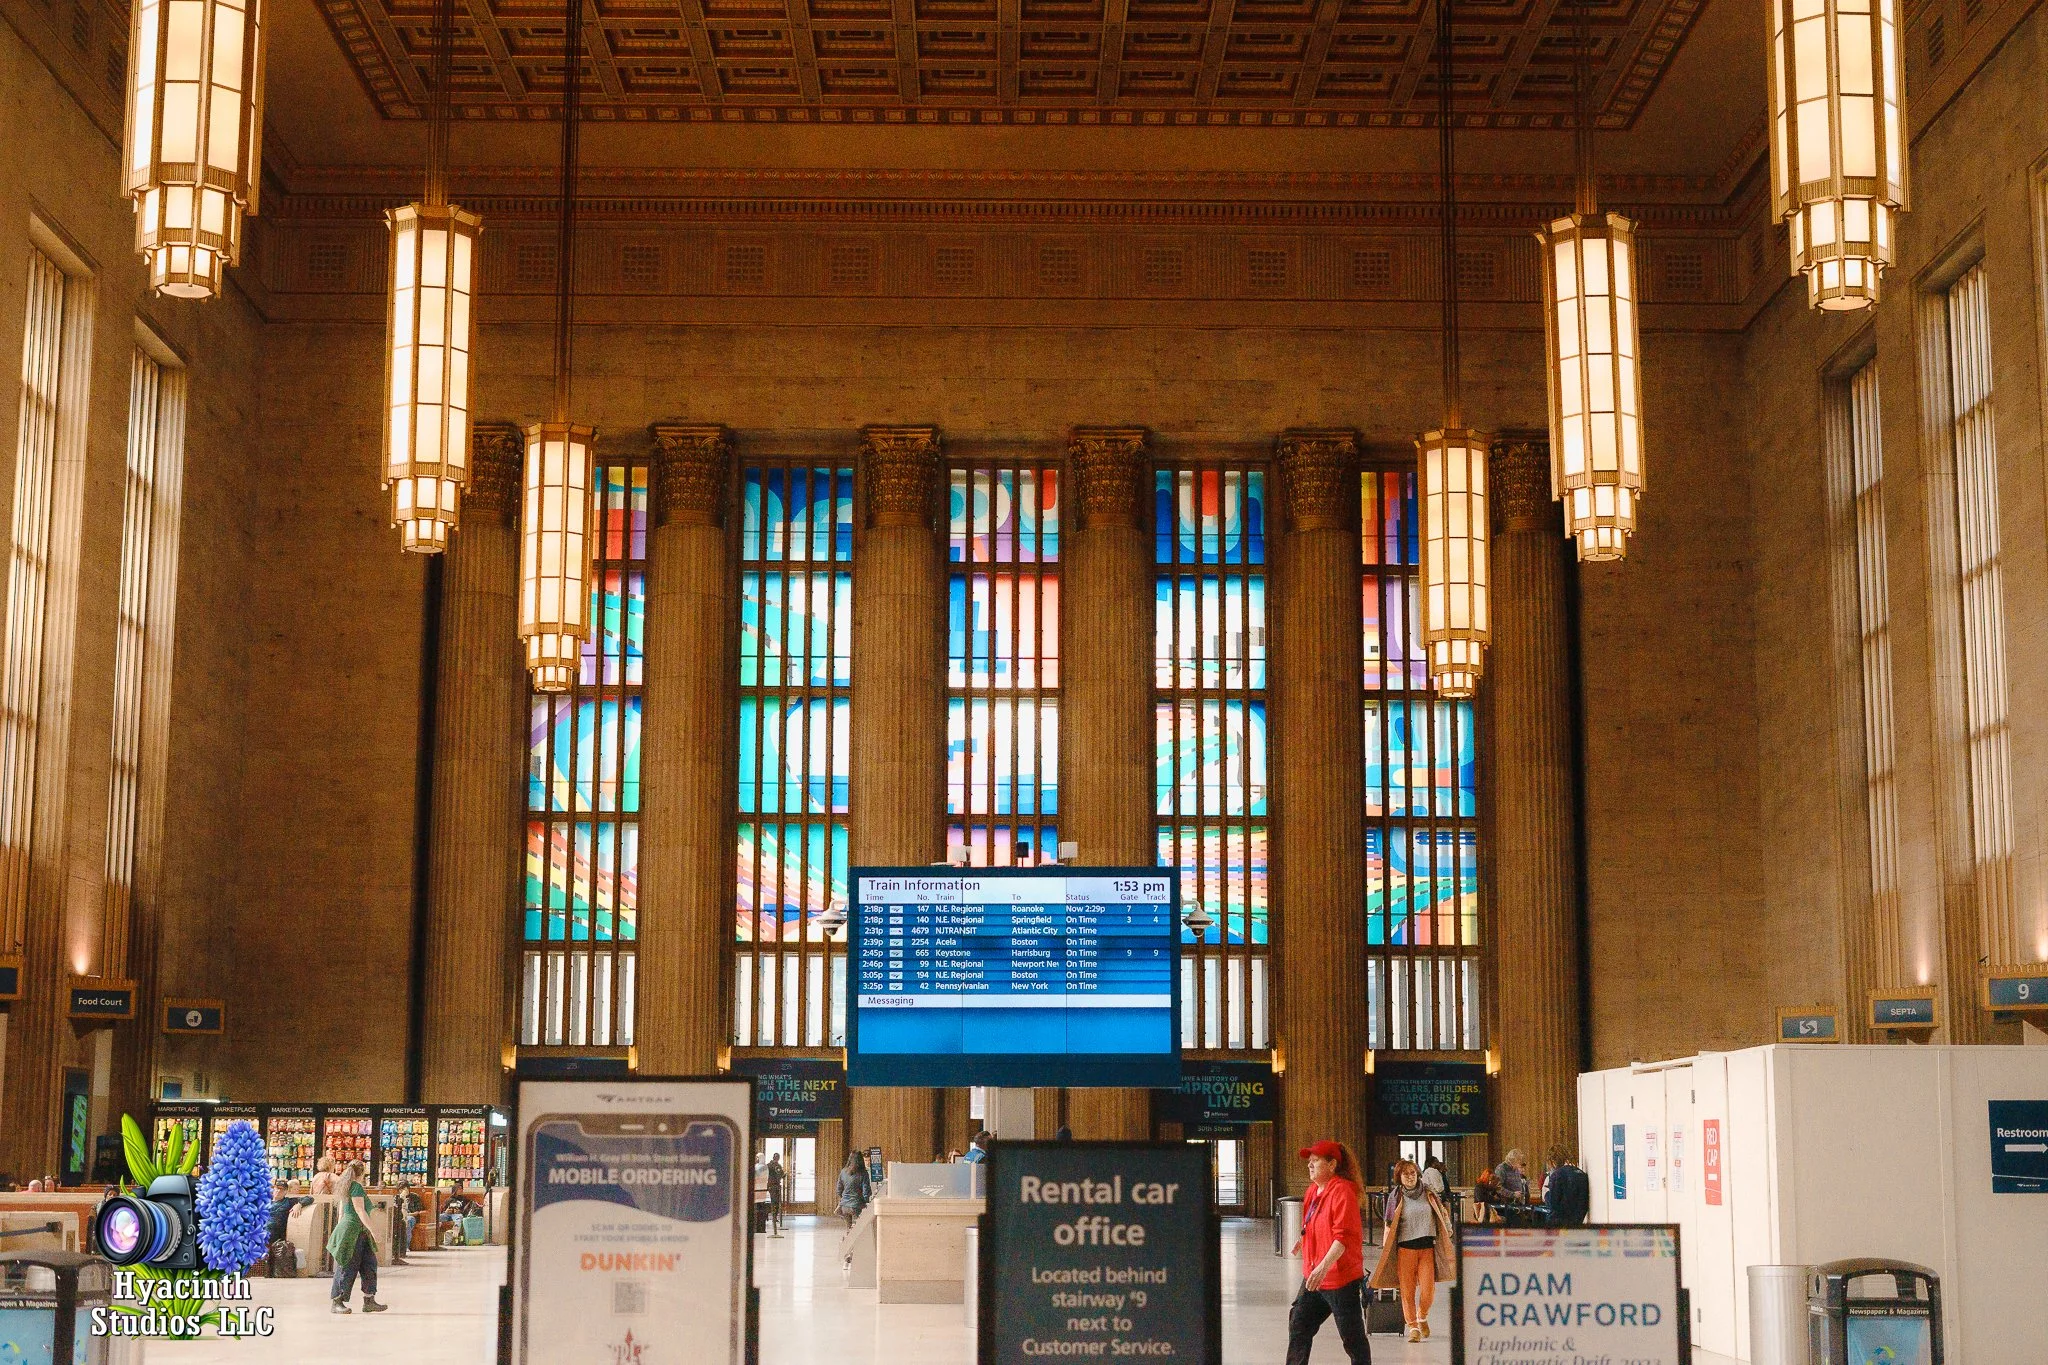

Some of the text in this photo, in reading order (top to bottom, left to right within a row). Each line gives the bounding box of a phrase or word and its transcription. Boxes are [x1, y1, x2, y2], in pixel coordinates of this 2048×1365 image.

[868, 880, 980, 890] Train Information
[1113, 881, 1165, 894] 1:53 pm
[951, 905, 984, 914] Regional
[1085, 906, 1105, 914] 2:29p
[951, 916, 984, 925] Regional
[1012, 917, 1052, 925] Springfield
[865, 927, 883, 935] 2:31p
[1043, 927, 1058, 935] City
[936, 950, 970, 958] Keystone
[1012, 950, 1050, 958] Harrisburg
[951, 961, 983, 969] Regional
[1012, 961, 1044, 969] Newport
[863, 972, 883, 980] 3:05p
[951, 972, 983, 980] Regional
[936, 983, 989, 991] Pennsylvanian
[2018, 984, 2029, 1000] 9
[100, 998, 122, 1006] Court
[868, 997, 914, 1006] Messaging
[1891, 1008, 1916, 1016] SEPTA
[776, 1080, 838, 1090] THE NEXT
[1434, 1085, 1481, 1094] BUILDERS,
[776, 1092, 817, 1101] YEARS
[1208, 1096, 1251, 1108] LIVES
[1389, 1103, 1470, 1115] CREATORS
[1706, 1128, 1717, 1145] RED
[1707, 1149, 1718, 1166] CAP
[548, 1168, 716, 1186] MOBILE ORDERING
[1020, 1175, 1179, 1204] Rental car
[1054, 1216, 1146, 1246] office
[581, 1252, 681, 1272] DUNKIN'
[1032, 1267, 1167, 1284] Located behind
[1477, 1273, 1572, 1296] ADAM
[1052, 1291, 1126, 1311] stairway
[1476, 1302, 1661, 1327] CRAWFORD
[1067, 1317, 1133, 1332] next to
[1022, 1339, 1176, 1356] Customer Service.
[1478, 1336, 1576, 1354] Euphonic &
[1477, 1355, 1568, 1365] Chromatic
